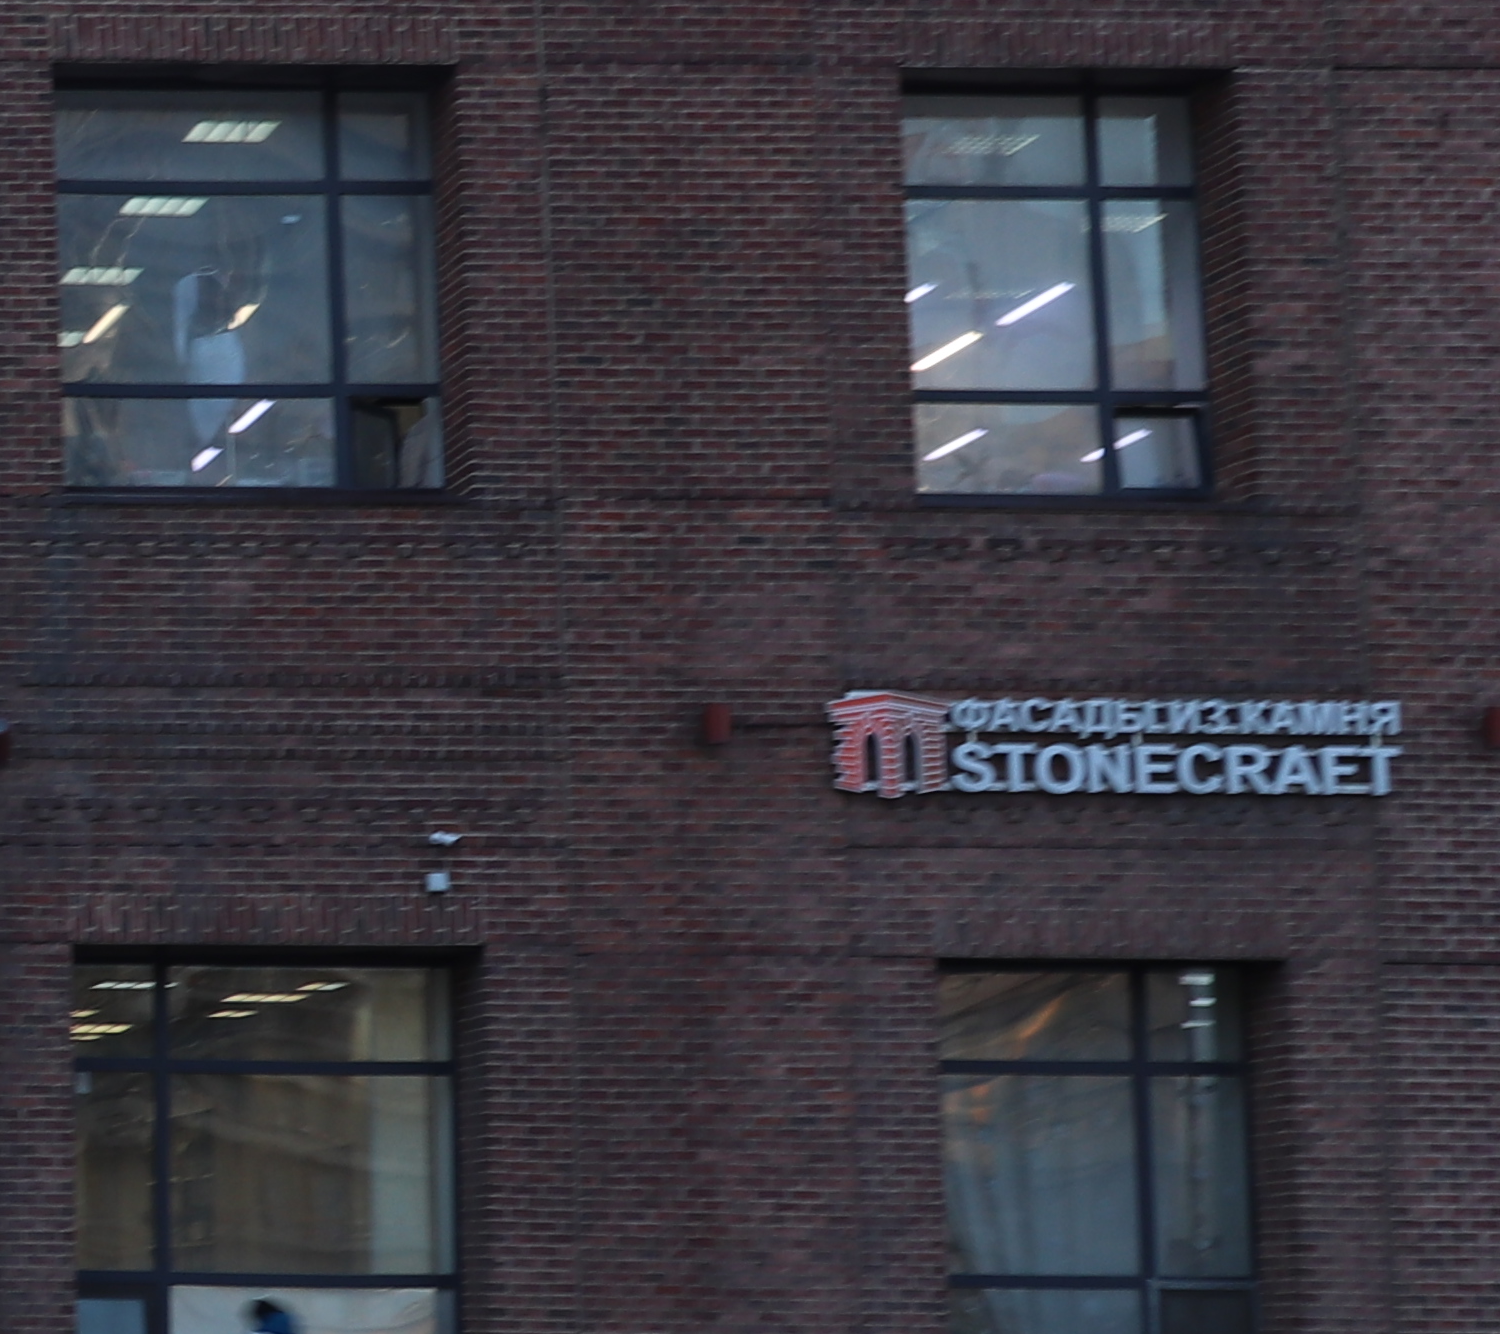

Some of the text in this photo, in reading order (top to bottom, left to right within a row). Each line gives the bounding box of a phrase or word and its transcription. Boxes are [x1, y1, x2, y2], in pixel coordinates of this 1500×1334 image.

[949, 698, 1402, 738] ФАСАДЫ ИЗ КАМНЯ
[949, 741, 1403, 796] STONECRAFT
